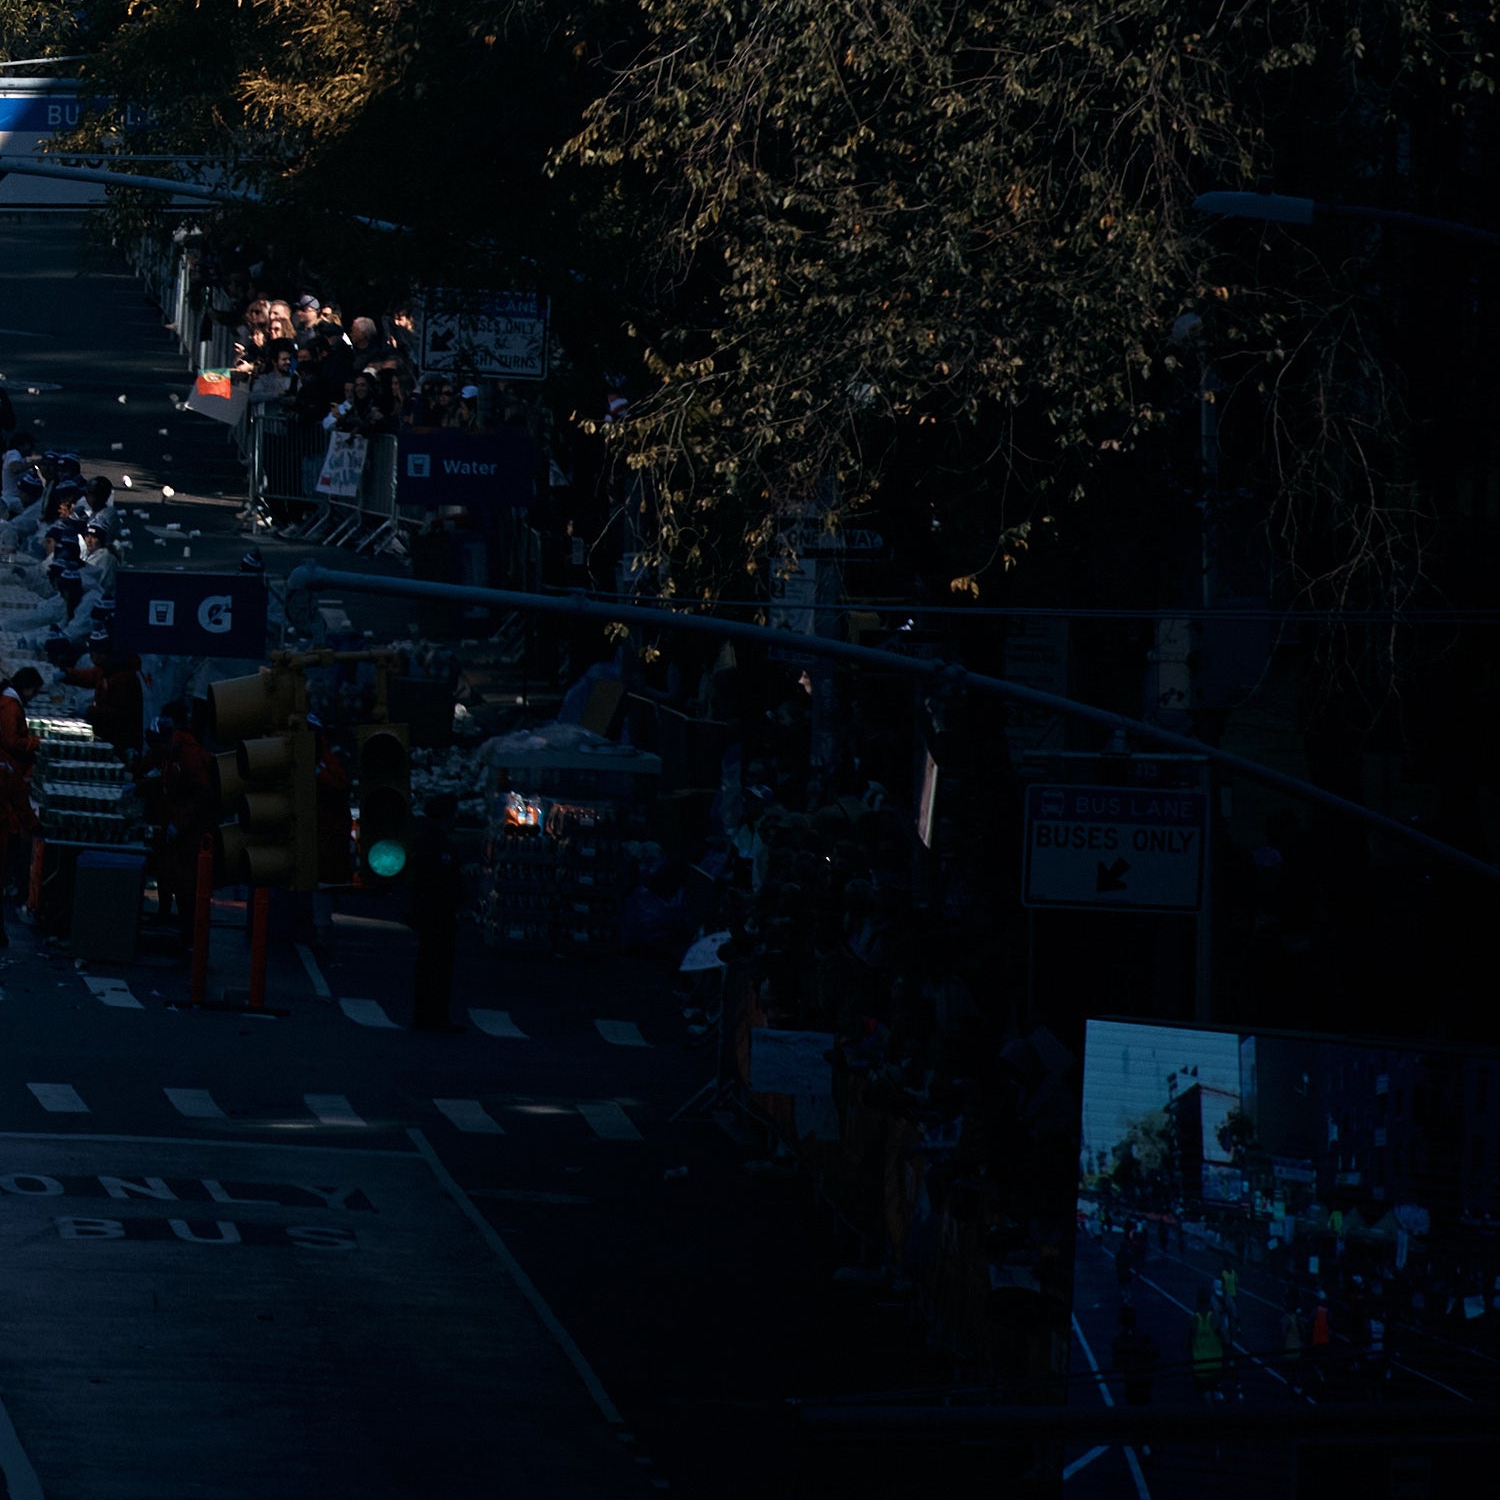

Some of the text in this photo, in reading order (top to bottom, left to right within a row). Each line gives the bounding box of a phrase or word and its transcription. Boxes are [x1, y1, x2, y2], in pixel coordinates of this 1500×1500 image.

[47, 105, 80, 127] BU
[443, 458, 499, 476] Water
[845, 532, 884, 550] WAY
[1076, 799, 1194, 819] BUS LANE
[1036, 825, 1196, 854] BUSES ONLY
[56, 1216, 358, 1251] BUS
